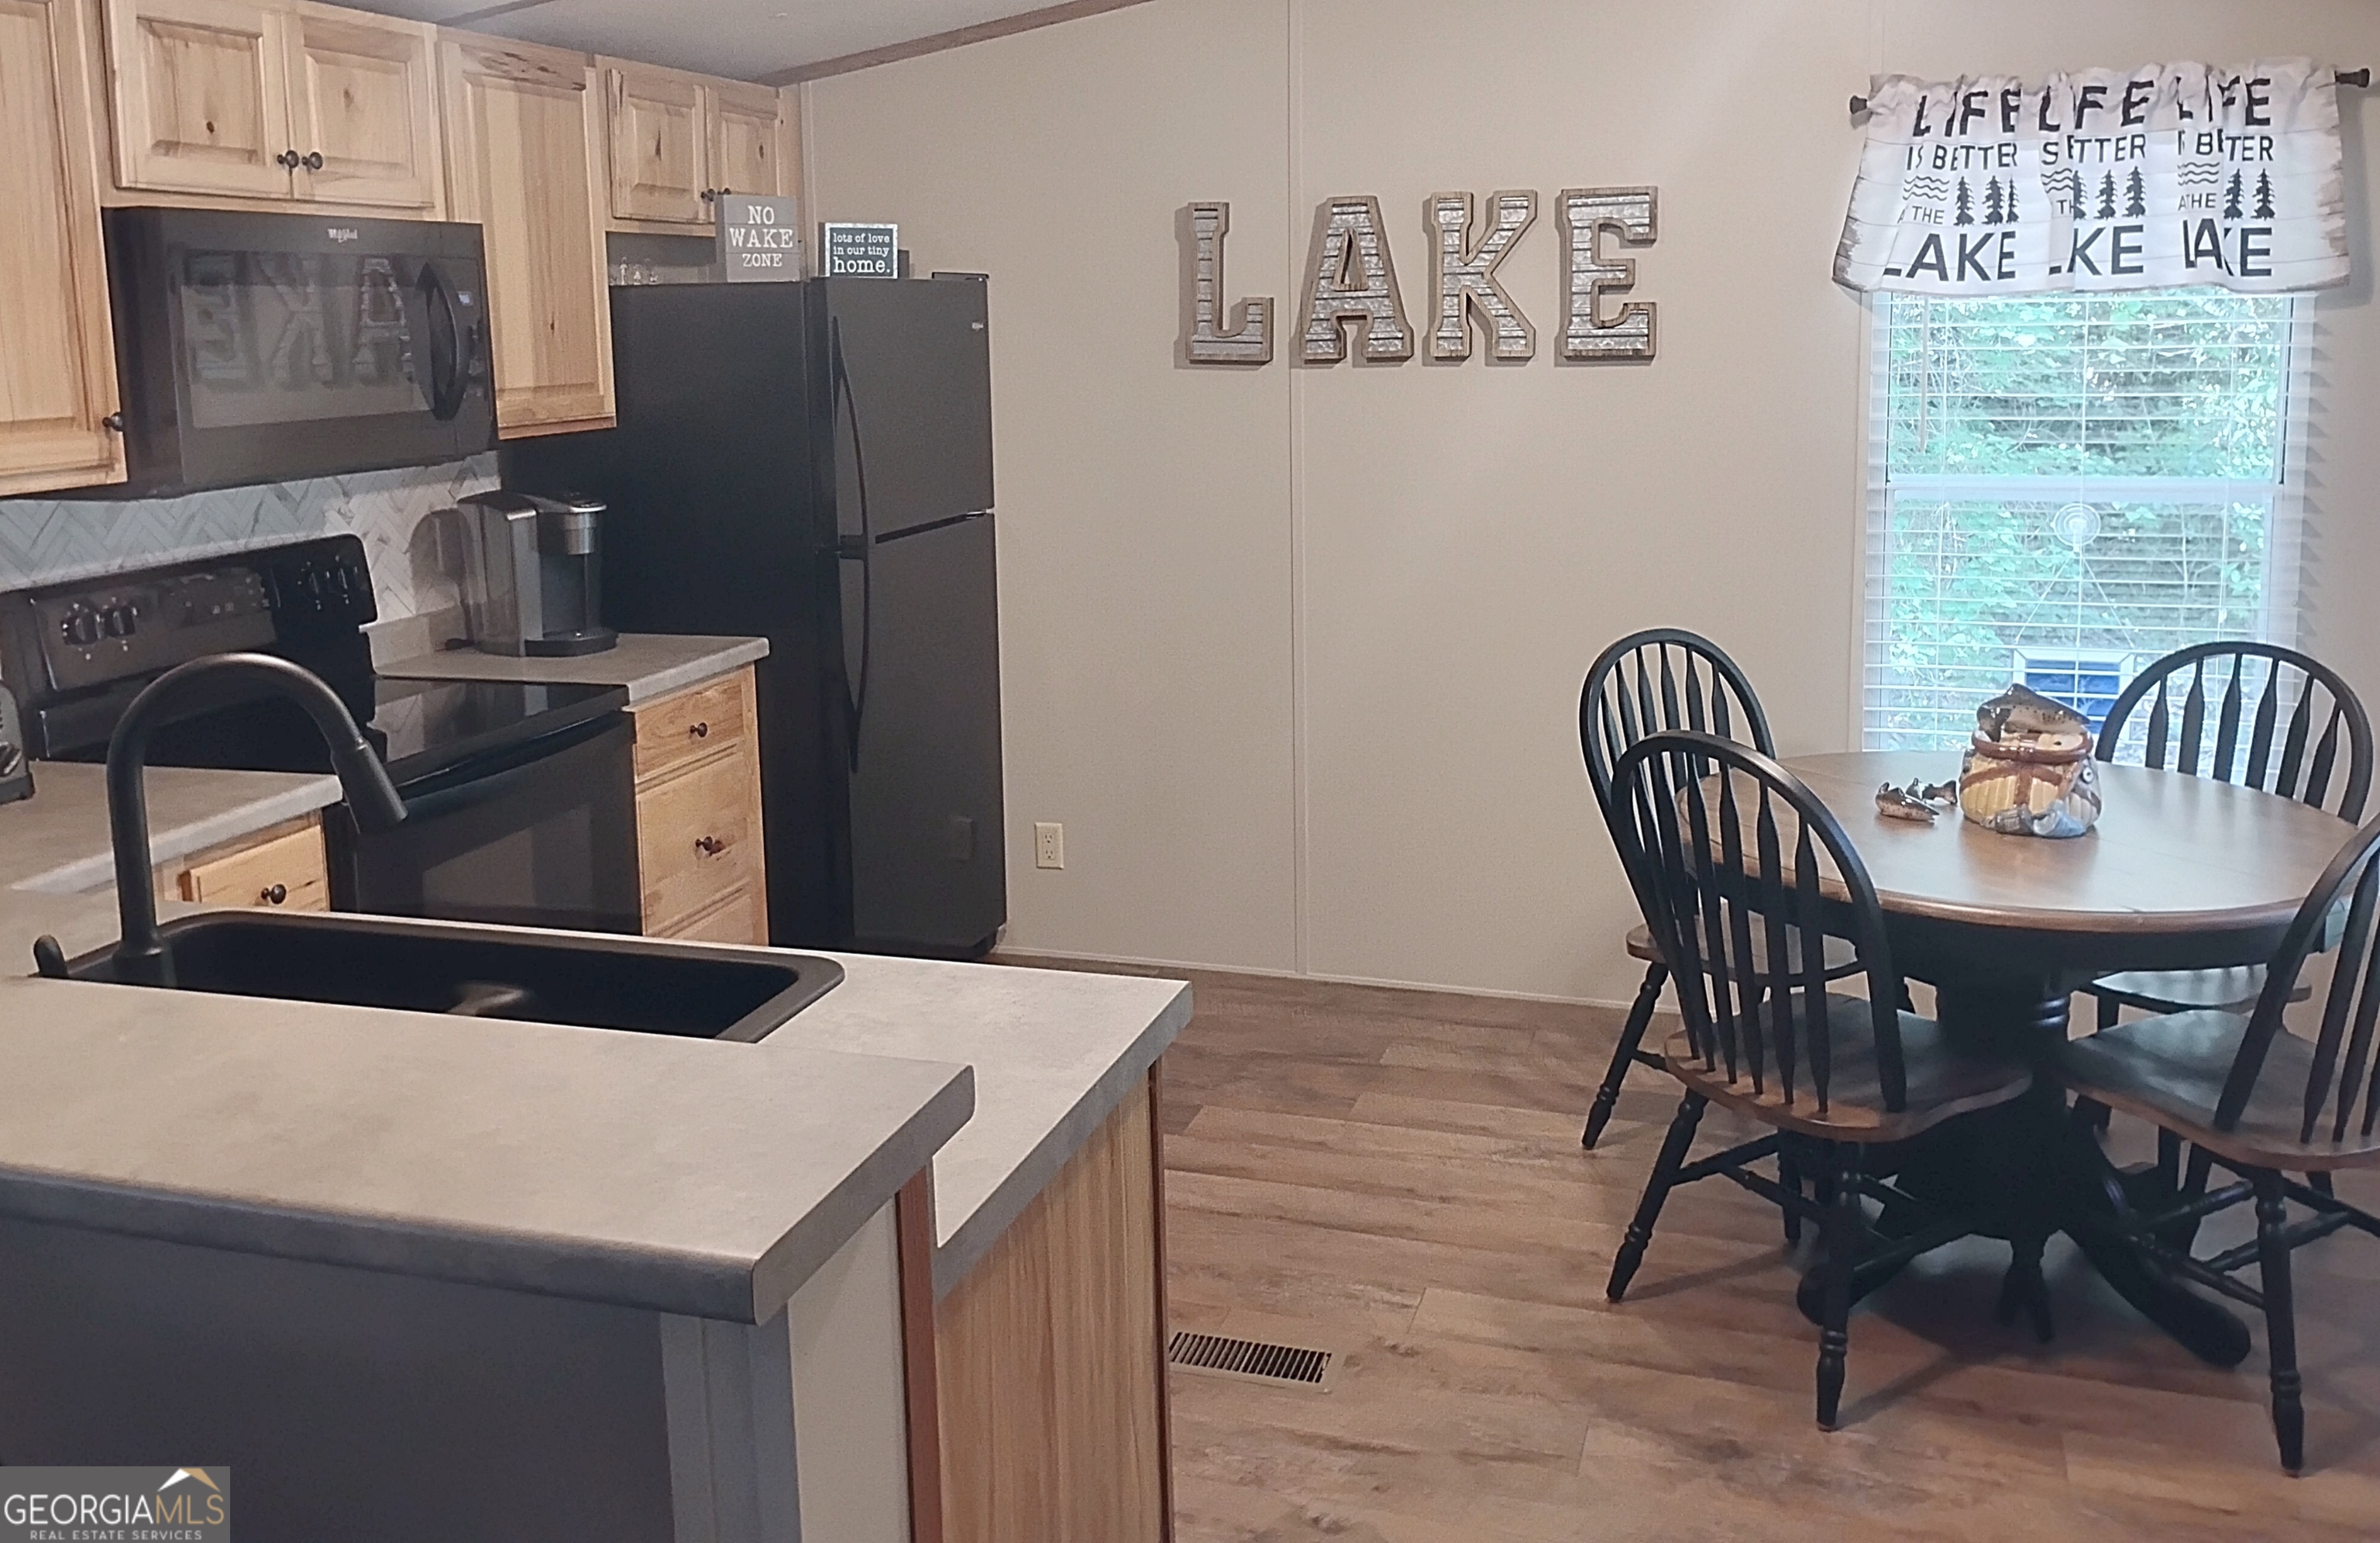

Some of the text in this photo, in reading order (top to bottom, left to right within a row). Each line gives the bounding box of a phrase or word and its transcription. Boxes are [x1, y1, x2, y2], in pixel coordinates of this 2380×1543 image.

[2039, 80, 2154, 132] LFE
[748, 205, 775, 225] NO
[1912, 205, 1945, 225] THE
[729, 227, 793, 248] WAKE
[833, 233, 890, 243] lots of love
[2183, 218, 2272, 277] LAE
[741, 253, 782, 267] ZONE
[833, 246, 889, 257] in our tiny
[833, 257, 891, 273] home.
[1187, 186, 1658, 364] LAKE
